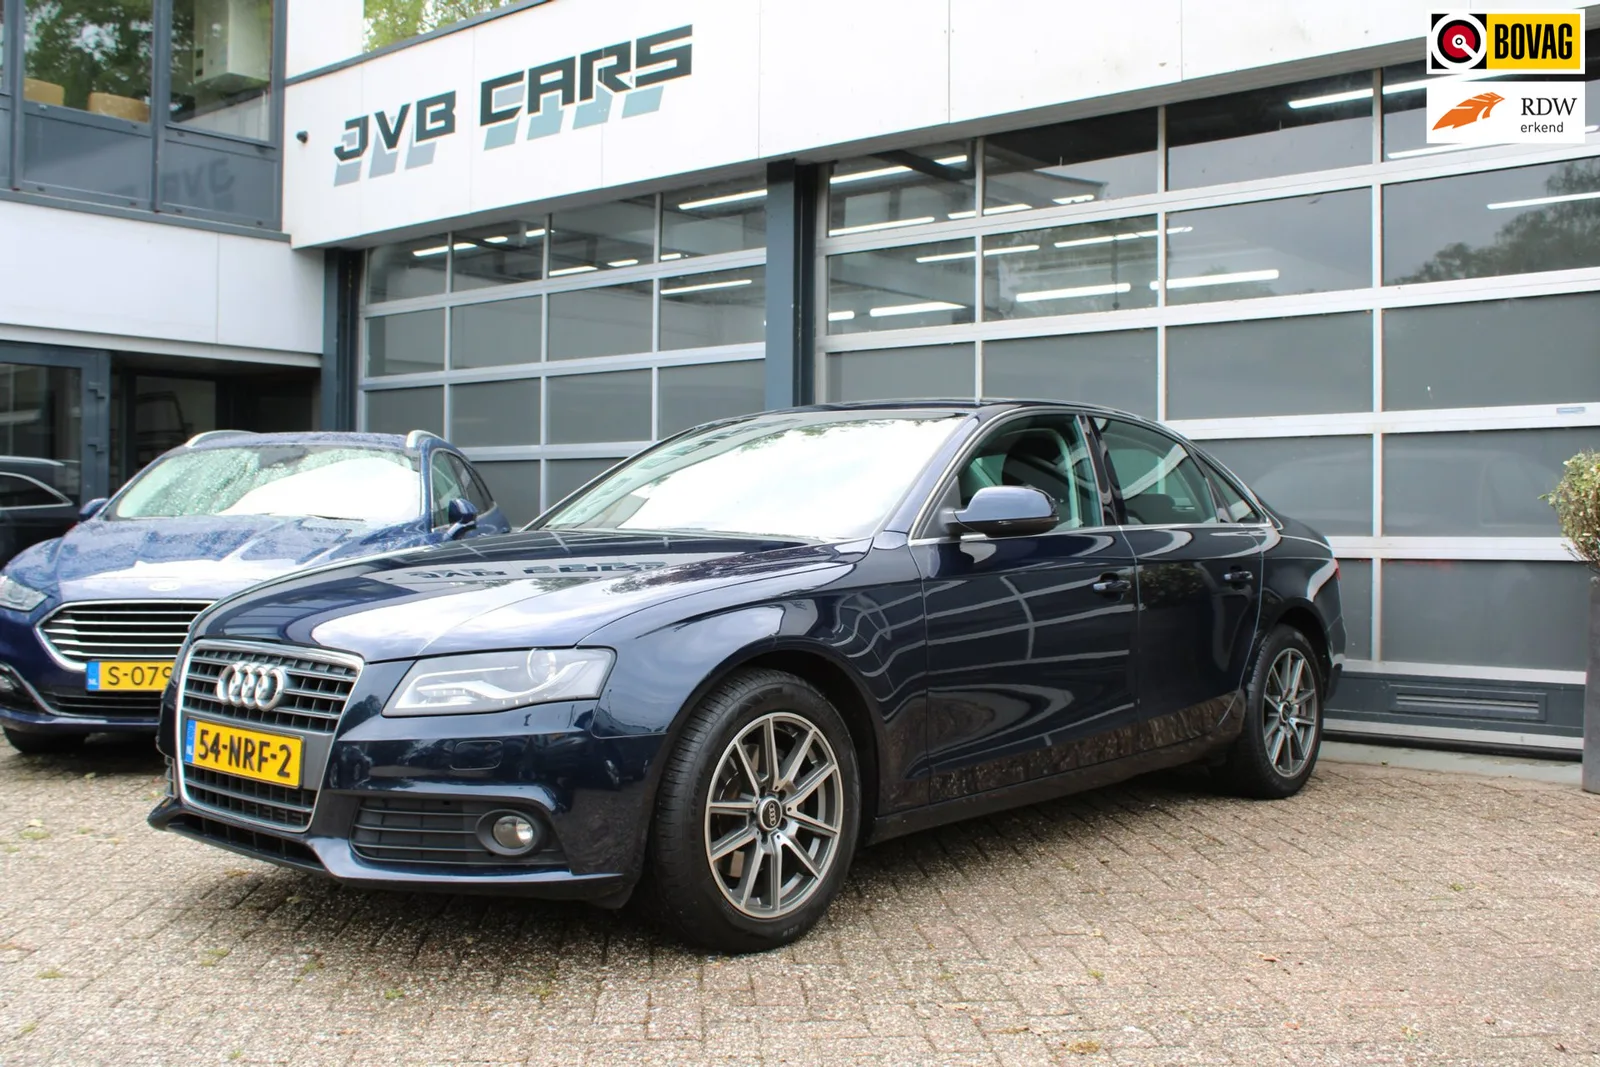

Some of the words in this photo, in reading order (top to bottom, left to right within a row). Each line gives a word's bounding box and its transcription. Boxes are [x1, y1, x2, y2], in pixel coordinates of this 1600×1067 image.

[334, 90, 456, 162] JVB
[480, 24, 693, 127] CARS
[198, 728, 292, 778] 54-NRF-2
